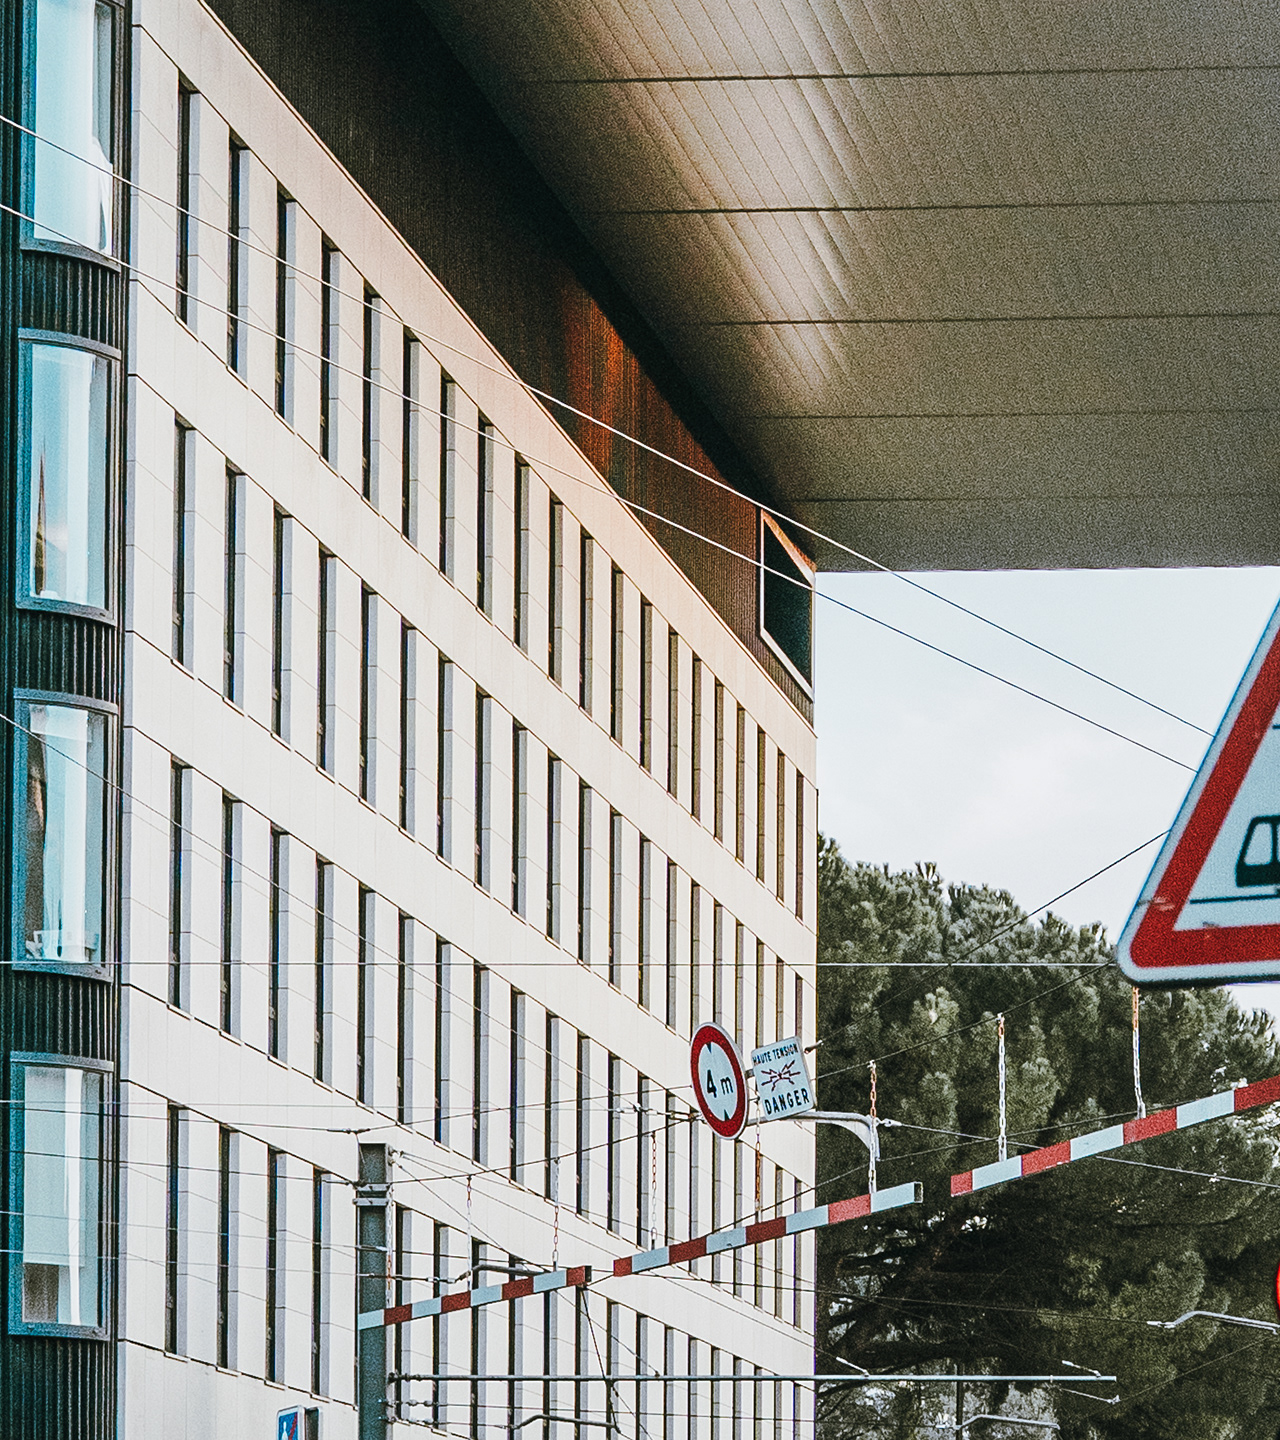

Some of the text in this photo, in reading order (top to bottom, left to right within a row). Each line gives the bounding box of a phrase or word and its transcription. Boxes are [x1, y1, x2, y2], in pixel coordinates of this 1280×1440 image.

[752, 1043, 799, 1066] HAUTE TENSION
[706, 1069, 734, 1098] 4 m
[764, 1087, 810, 1115] DANGER
